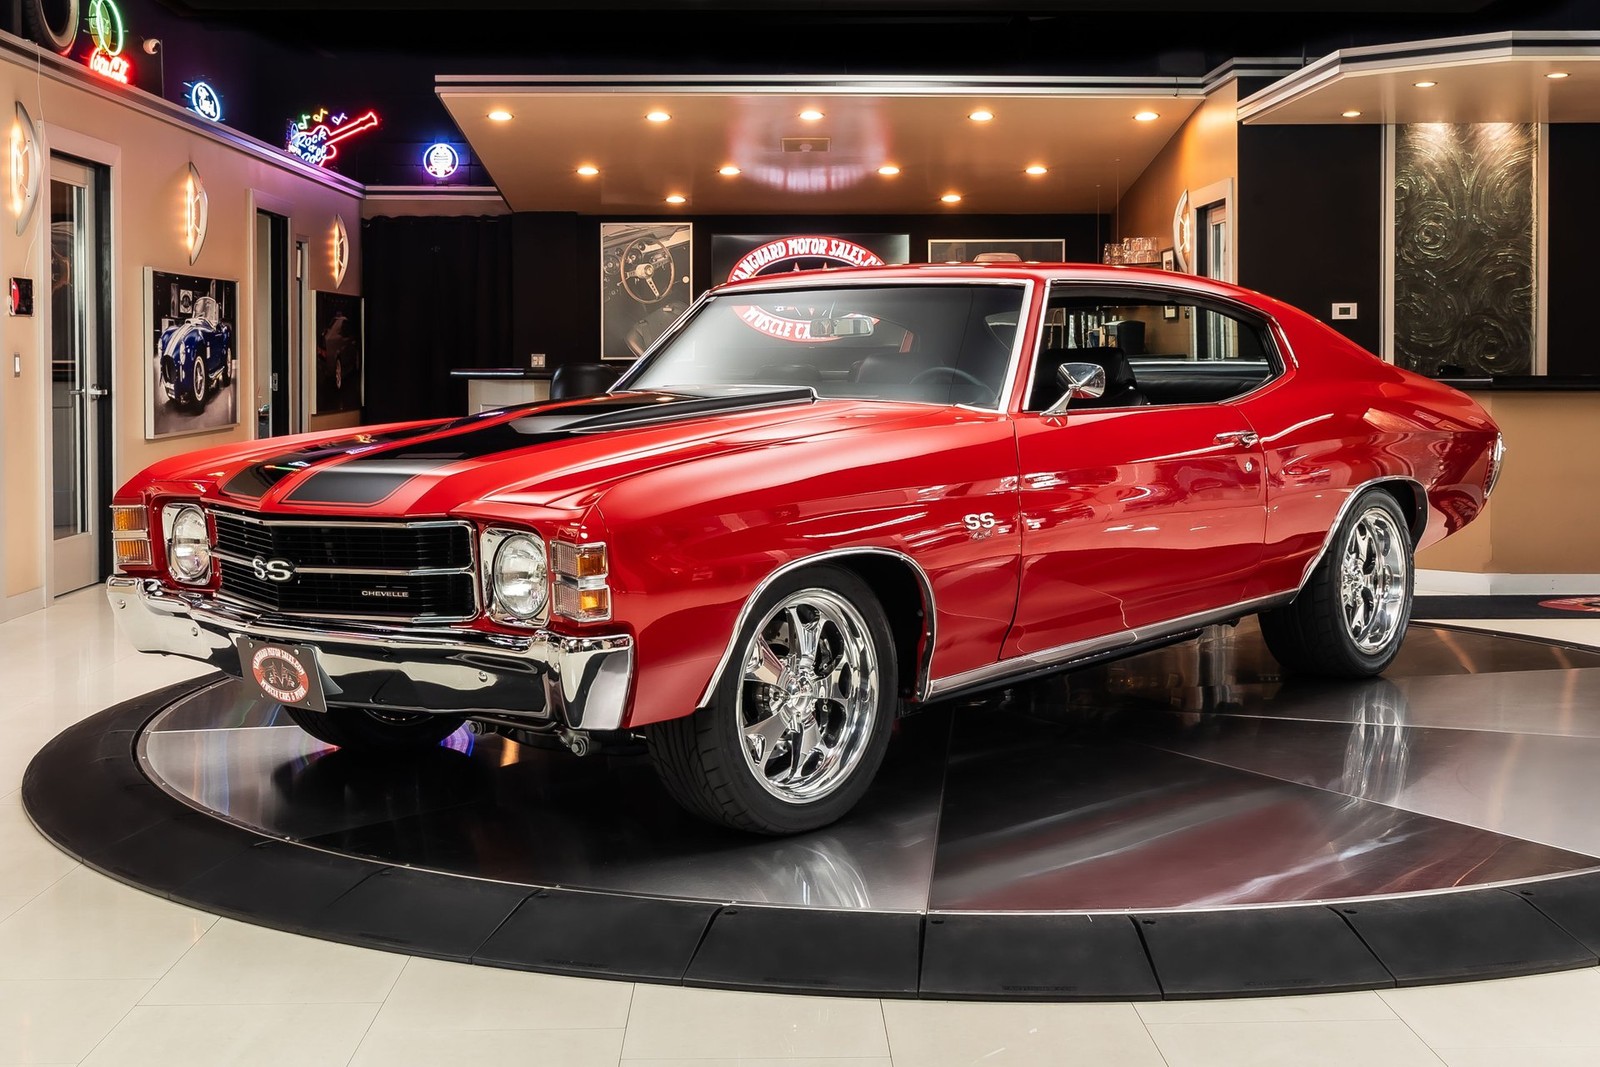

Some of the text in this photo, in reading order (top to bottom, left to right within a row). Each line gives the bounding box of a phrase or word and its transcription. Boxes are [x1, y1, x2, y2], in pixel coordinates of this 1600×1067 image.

[297, 127, 327, 148] Rock
[787, 238, 828, 255] MOTOR
[743, 306, 793, 337] MUSCLE
[964, 512, 995, 530] SS
[253, 559, 291, 580] SS
[361, 590, 409, 598] CHEVELLE
